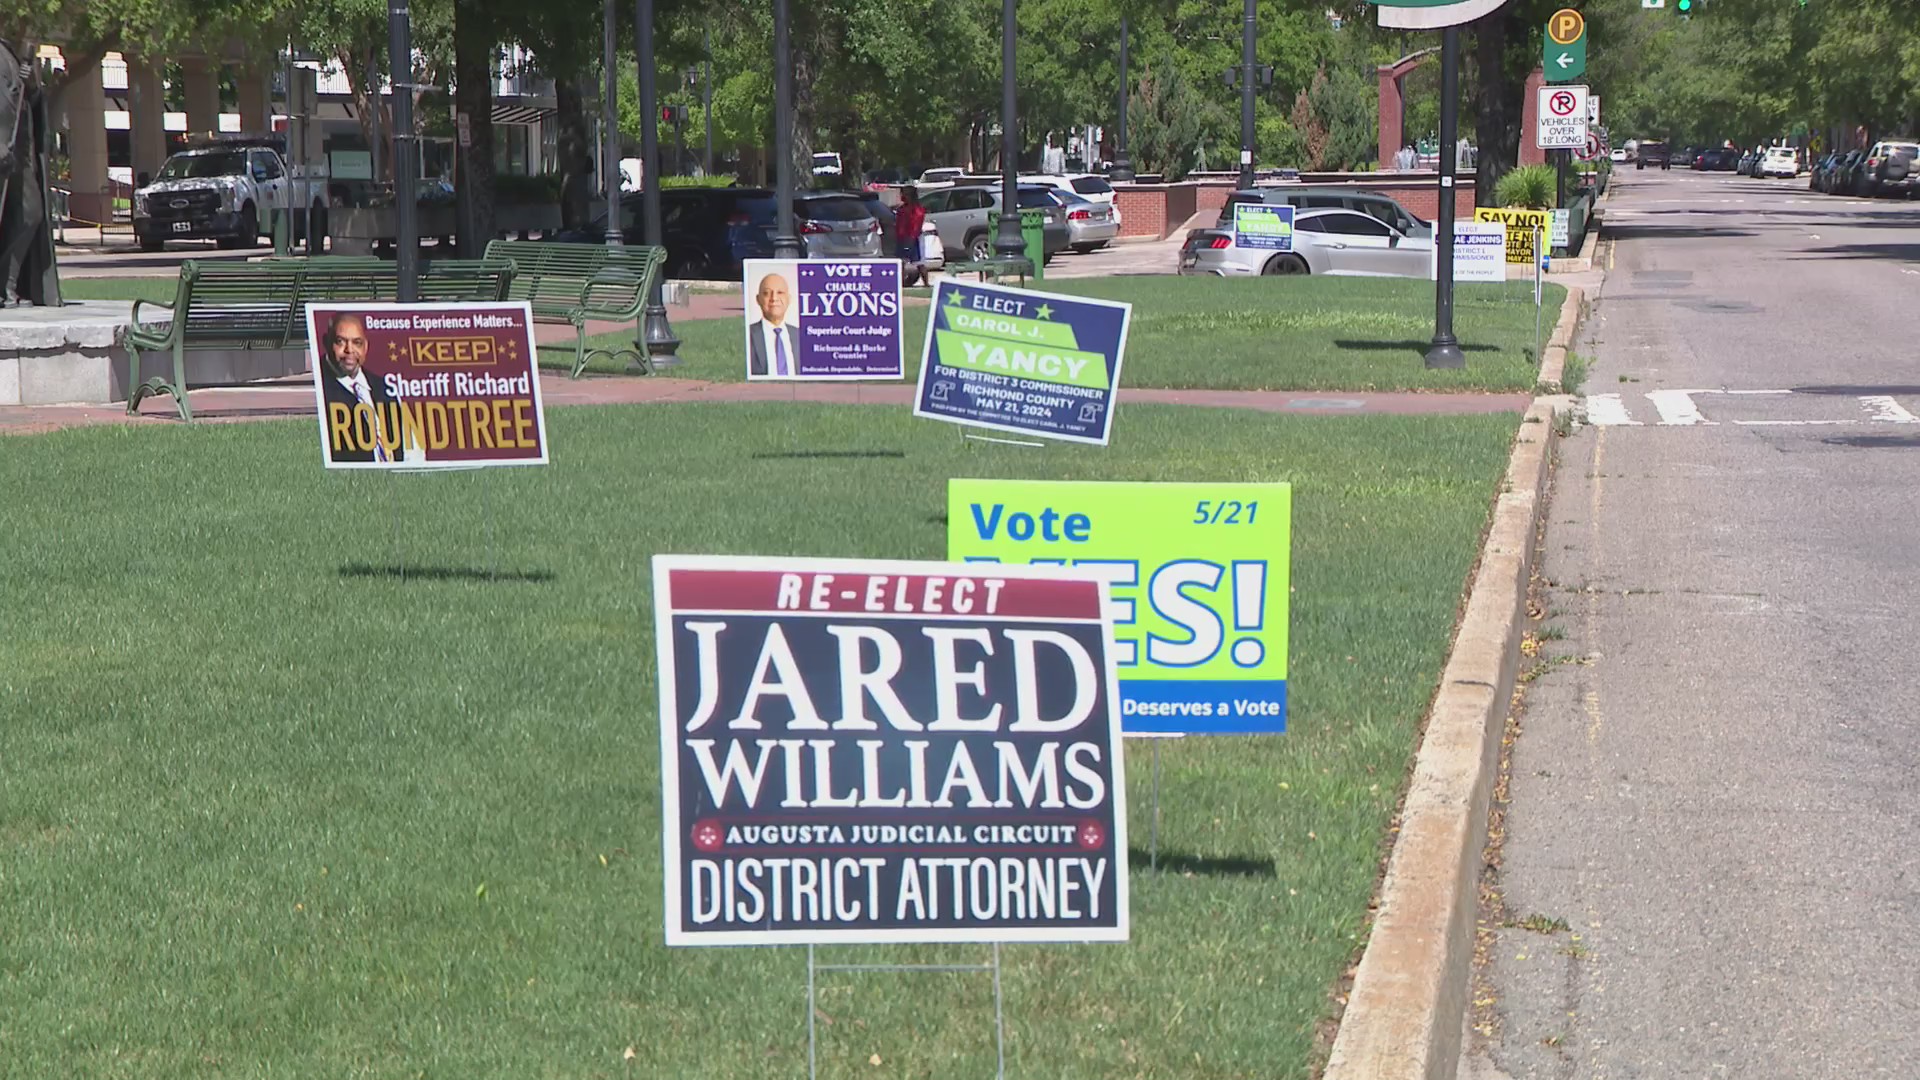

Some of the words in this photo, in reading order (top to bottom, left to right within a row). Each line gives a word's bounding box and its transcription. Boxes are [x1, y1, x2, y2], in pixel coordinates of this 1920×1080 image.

[1558, 16, 1576, 39] P
[1541, 117, 1585, 126] VEHICLES
[1549, 126, 1575, 135] OVER
[1555, 135, 1582, 144] LONG
[1480, 211, 1512, 223] SAY
[1515, 213, 1545, 228] NO!
[1466, 235, 1502, 244] JENKINS
[824, 264, 872, 277] VOTE
[825, 282, 871, 292] CHARLES
[800, 293, 897, 316] LYONS
[972, 294, 1026, 315] ELECT
[365, 314, 411, 330] Because
[413, 314, 471, 332] Experience
[473, 313, 523, 329] Matters...
[807, 326, 842, 337] Superior
[843, 326, 866, 335] Court
[867, 326, 892, 337] Judge
[956, 314, 1022, 336] CAROL
[1026, 326, 1044, 339] J.
[415, 341, 491, 362] KEEP
[813, 344, 853, 352] Richmond
[962, 341, 1089, 380] YANCY
[384, 372, 450, 397] Sheriff
[454, 371, 530, 396] Richard
[934, 365, 957, 378] FOR
[958, 368, 1008, 386] DISTRICT
[1011, 377, 1019, 388] 3
[1019, 379, 1104, 400] COMMISSIONER
[962, 383, 1025, 402] RICHMOND
[1026, 392, 1075, 409] COUNTY
[976, 398, 1003, 411] MAY
[1004, 401, 1020, 414] 21,
[1021, 404, 1053, 418] 2024
[329, 399, 537, 452] ROUNDTREE
[970, 503, 1091, 542] Vote
[1193, 501, 1258, 524] 5/21
[776, 573, 1006, 615] RE-ELECT
[683, 620, 1098, 733] JARED
[1123, 699, 1213, 717] Deserves
[1217, 703, 1230, 716] a
[1233, 699, 1280, 716] Vote
[685, 738, 1105, 810] WILLIAMS
[726, 824, 845, 844] AUGUSTA
[851, 824, 967, 844] JUDICIAL
[974, 824, 1076, 844] CIRCUIT
[690, 857, 887, 925] DISTRICT
[896, 856, 1108, 922] ATTORNEY
